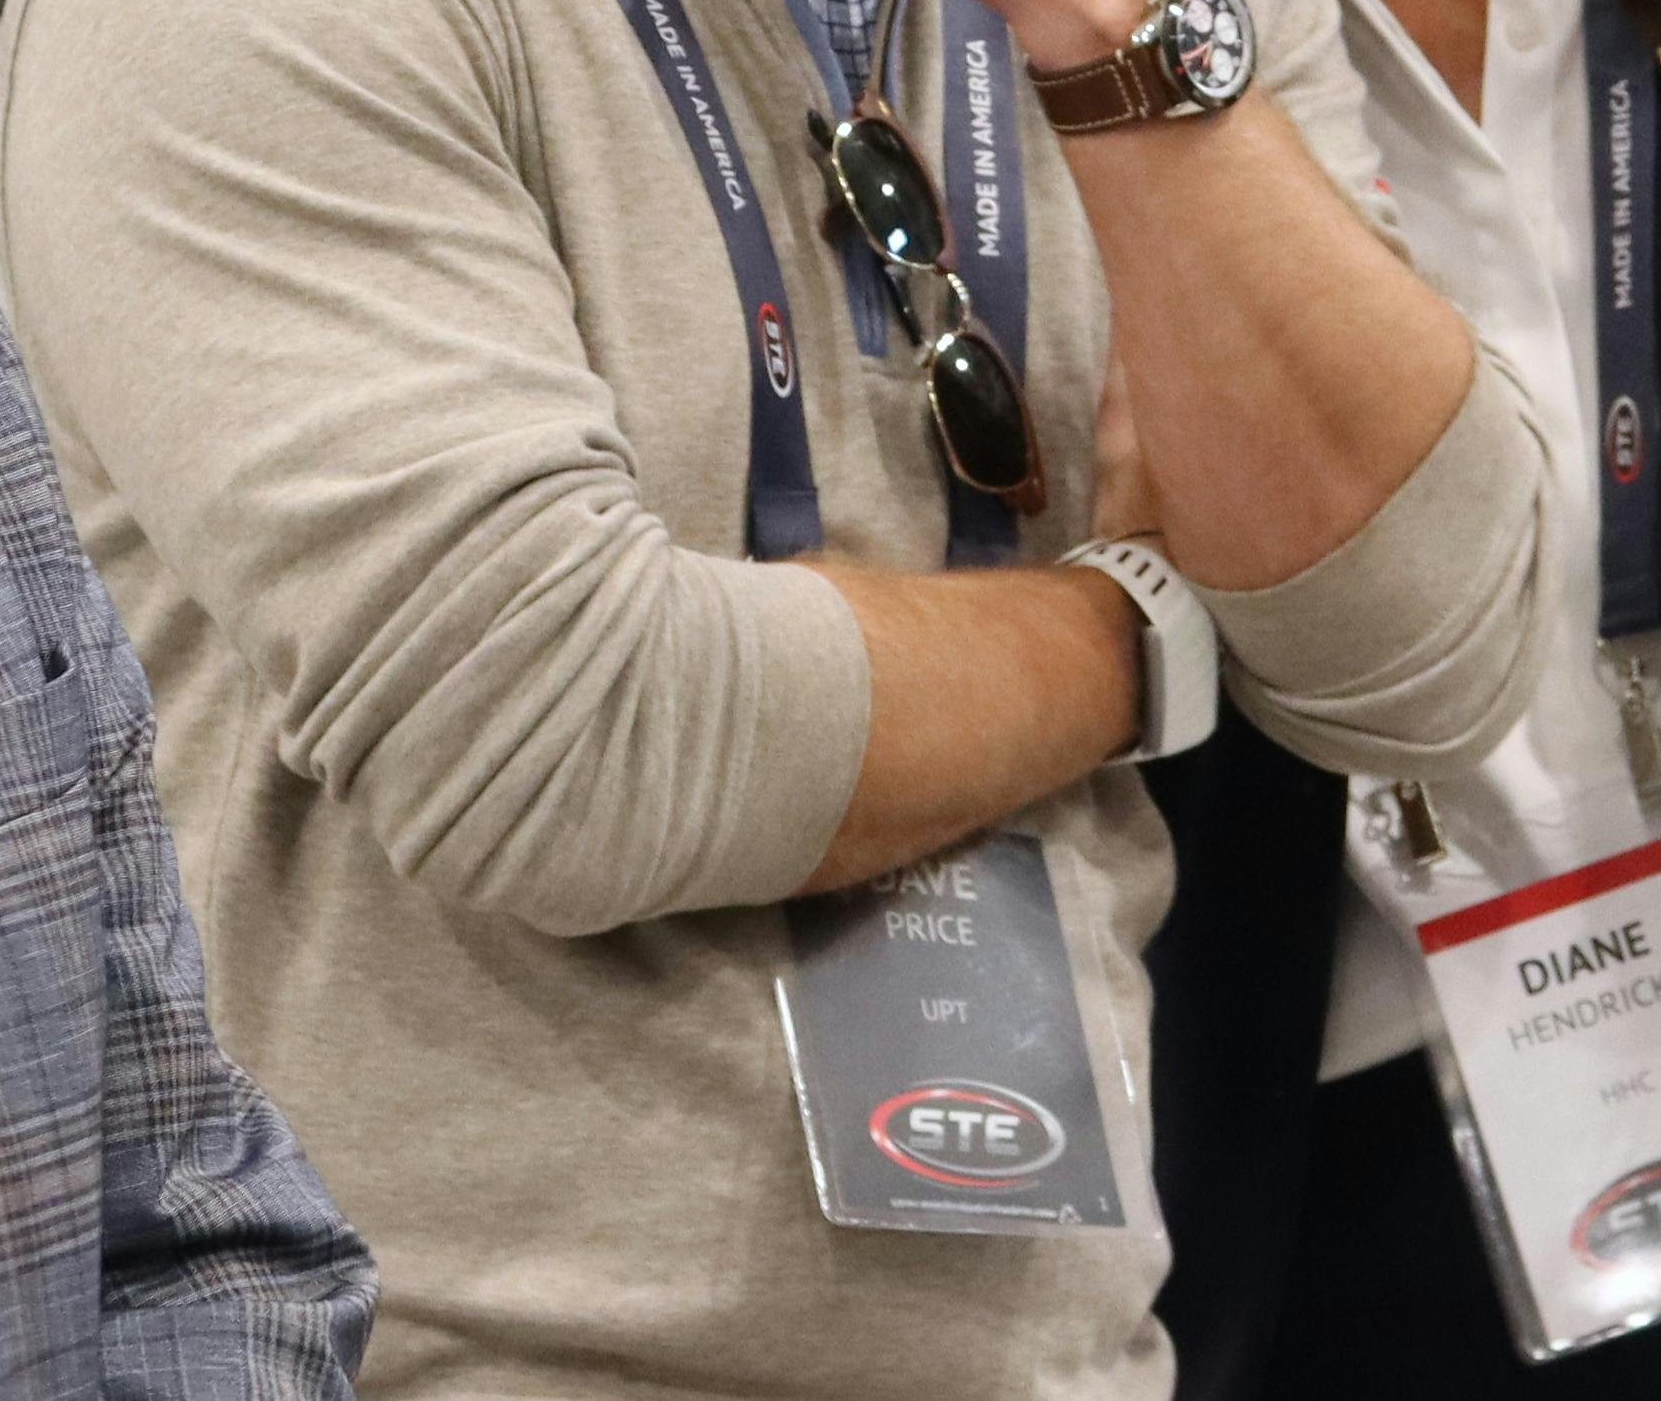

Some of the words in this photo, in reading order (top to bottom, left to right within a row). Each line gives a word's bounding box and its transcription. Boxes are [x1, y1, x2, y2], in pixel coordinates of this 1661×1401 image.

[965, 39, 994, 144] AMERICA
[676, 65, 702, 93] IN
[690, 96, 747, 211] AMERICA
[974, 149, 997, 178] IN
[1608, 79, 1632, 193] AMERICA
[975, 182, 1001, 257] MADE
[1612, 198, 1632, 227] IN
[1612, 233, 1633, 310] MADE
[885, 909, 979, 947] PRICE
[1517, 920, 1652, 997] DIANE
[919, 997, 968, 1025] UPT
[907, 1107, 1022, 1157] STE
